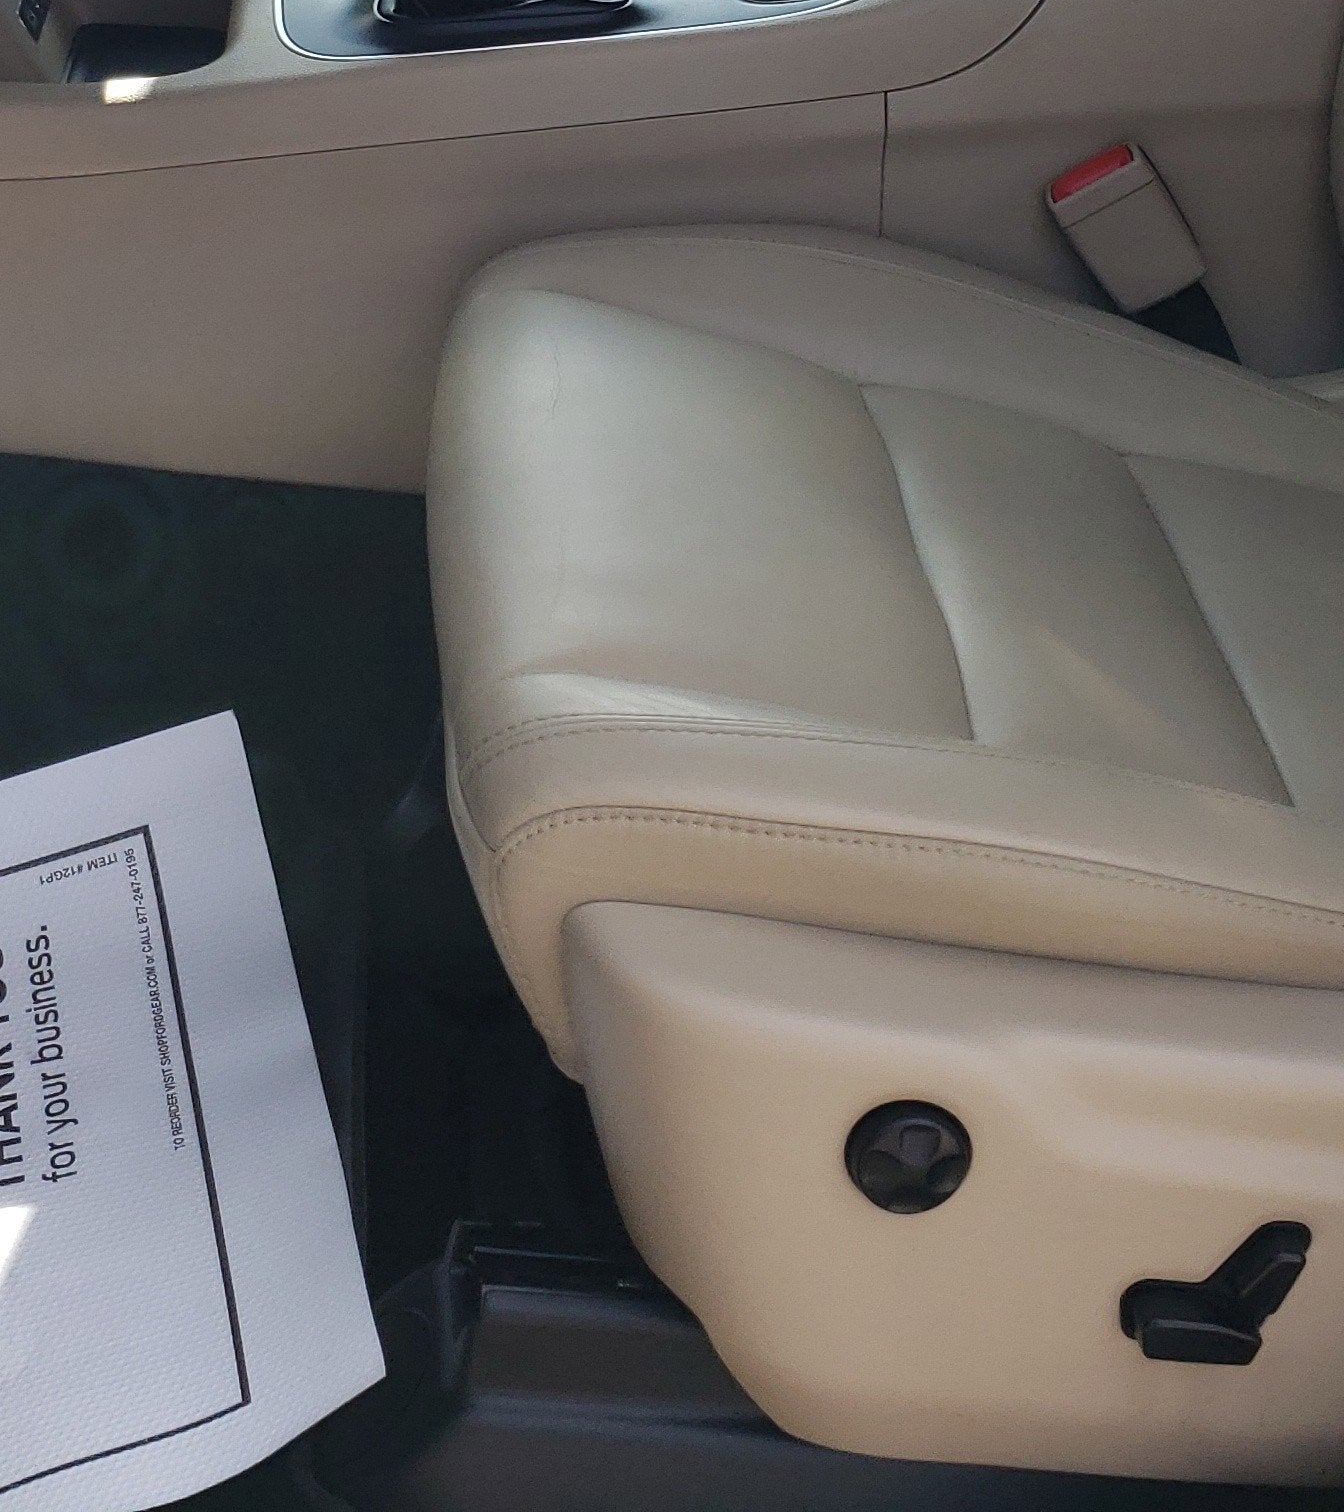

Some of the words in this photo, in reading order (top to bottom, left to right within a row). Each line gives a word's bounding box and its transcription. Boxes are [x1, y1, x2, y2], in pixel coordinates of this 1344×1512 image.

[39, 864, 83, 885] #12GP1
[87, 853, 118, 871] ITEM
[123, 848, 148, 924] 877-247-0195
[138, 926, 154, 953] CALL
[146, 954, 156, 965] or
[25, 925, 64, 1065] business.
[144, 966, 171, 1067] SHOPFORDGEAR.COM
[161, 1068, 176, 1093] VISIT
[41, 1072, 79, 1135] your
[167, 1093, 184, 1136] REORDER
[173, 1136, 186, 1151] TO
[42, 1141, 78, 1182] for
